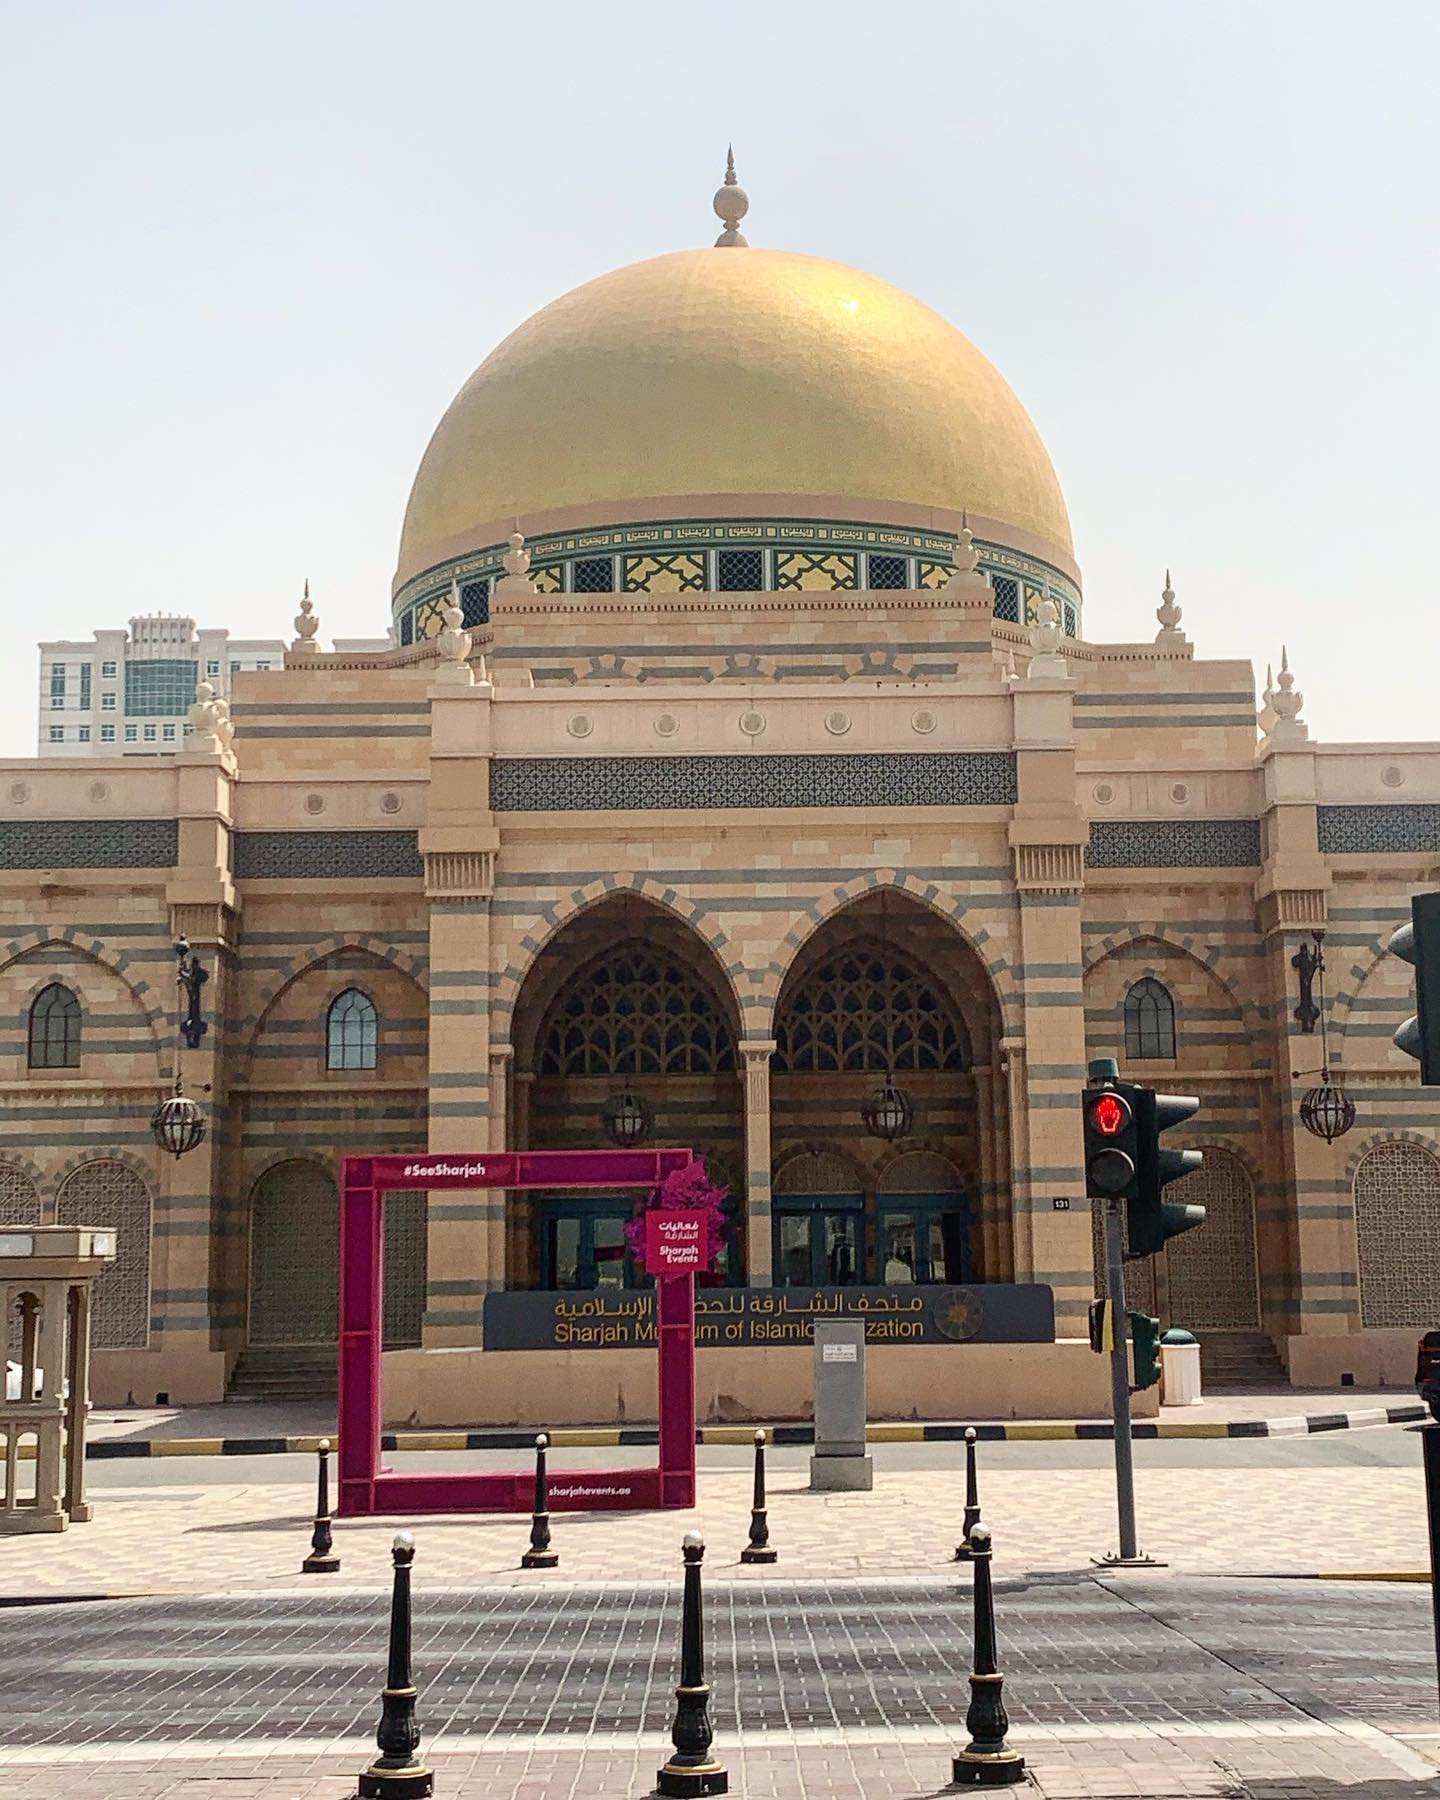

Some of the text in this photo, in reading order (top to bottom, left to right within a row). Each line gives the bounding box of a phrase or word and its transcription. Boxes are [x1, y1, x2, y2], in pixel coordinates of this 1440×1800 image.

[404, 1163, 485, 1178] #SeeSharjah
[658, 1221, 699, 1231] فعاليات
[665, 1231, 698, 1240] الشارقة
[660, 1245, 698, 1256] Sharjah
[667, 1255, 698, 1263] Events
[554, 1291, 923, 1321] متحف الشارقة للحض الإسلامية
[554, 1322, 628, 1345] Sharjah
[725, 1320, 744, 1339] of
[549, 1485, 631, 1498] sharjahevents.ae
